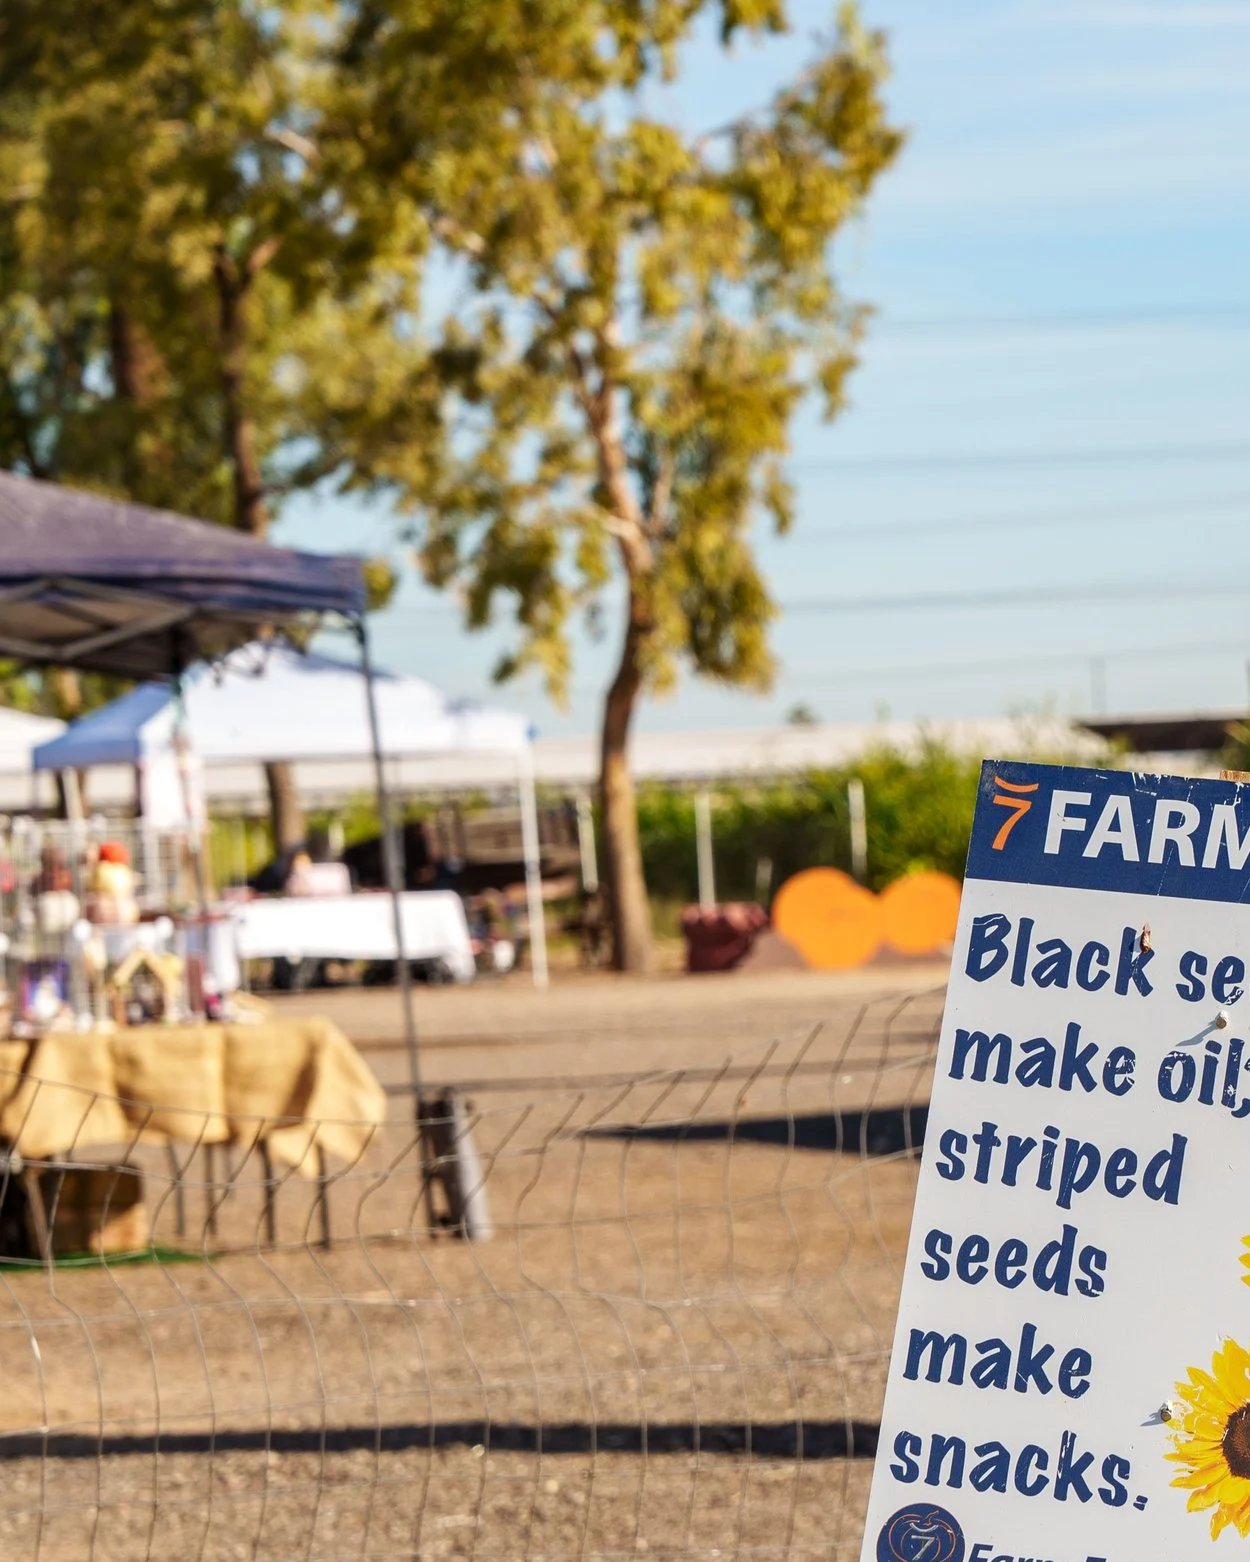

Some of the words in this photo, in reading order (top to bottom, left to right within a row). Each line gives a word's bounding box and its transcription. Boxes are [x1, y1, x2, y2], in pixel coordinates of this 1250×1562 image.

[964, 913, 1153, 997] Black
[948, 1022, 1136, 1096] make
[936, 1121, 1188, 1210] striped
[921, 1224, 1107, 1298] seeds
[903, 1322, 1092, 1398] make
[889, 1430, 1148, 1512] snacks.
